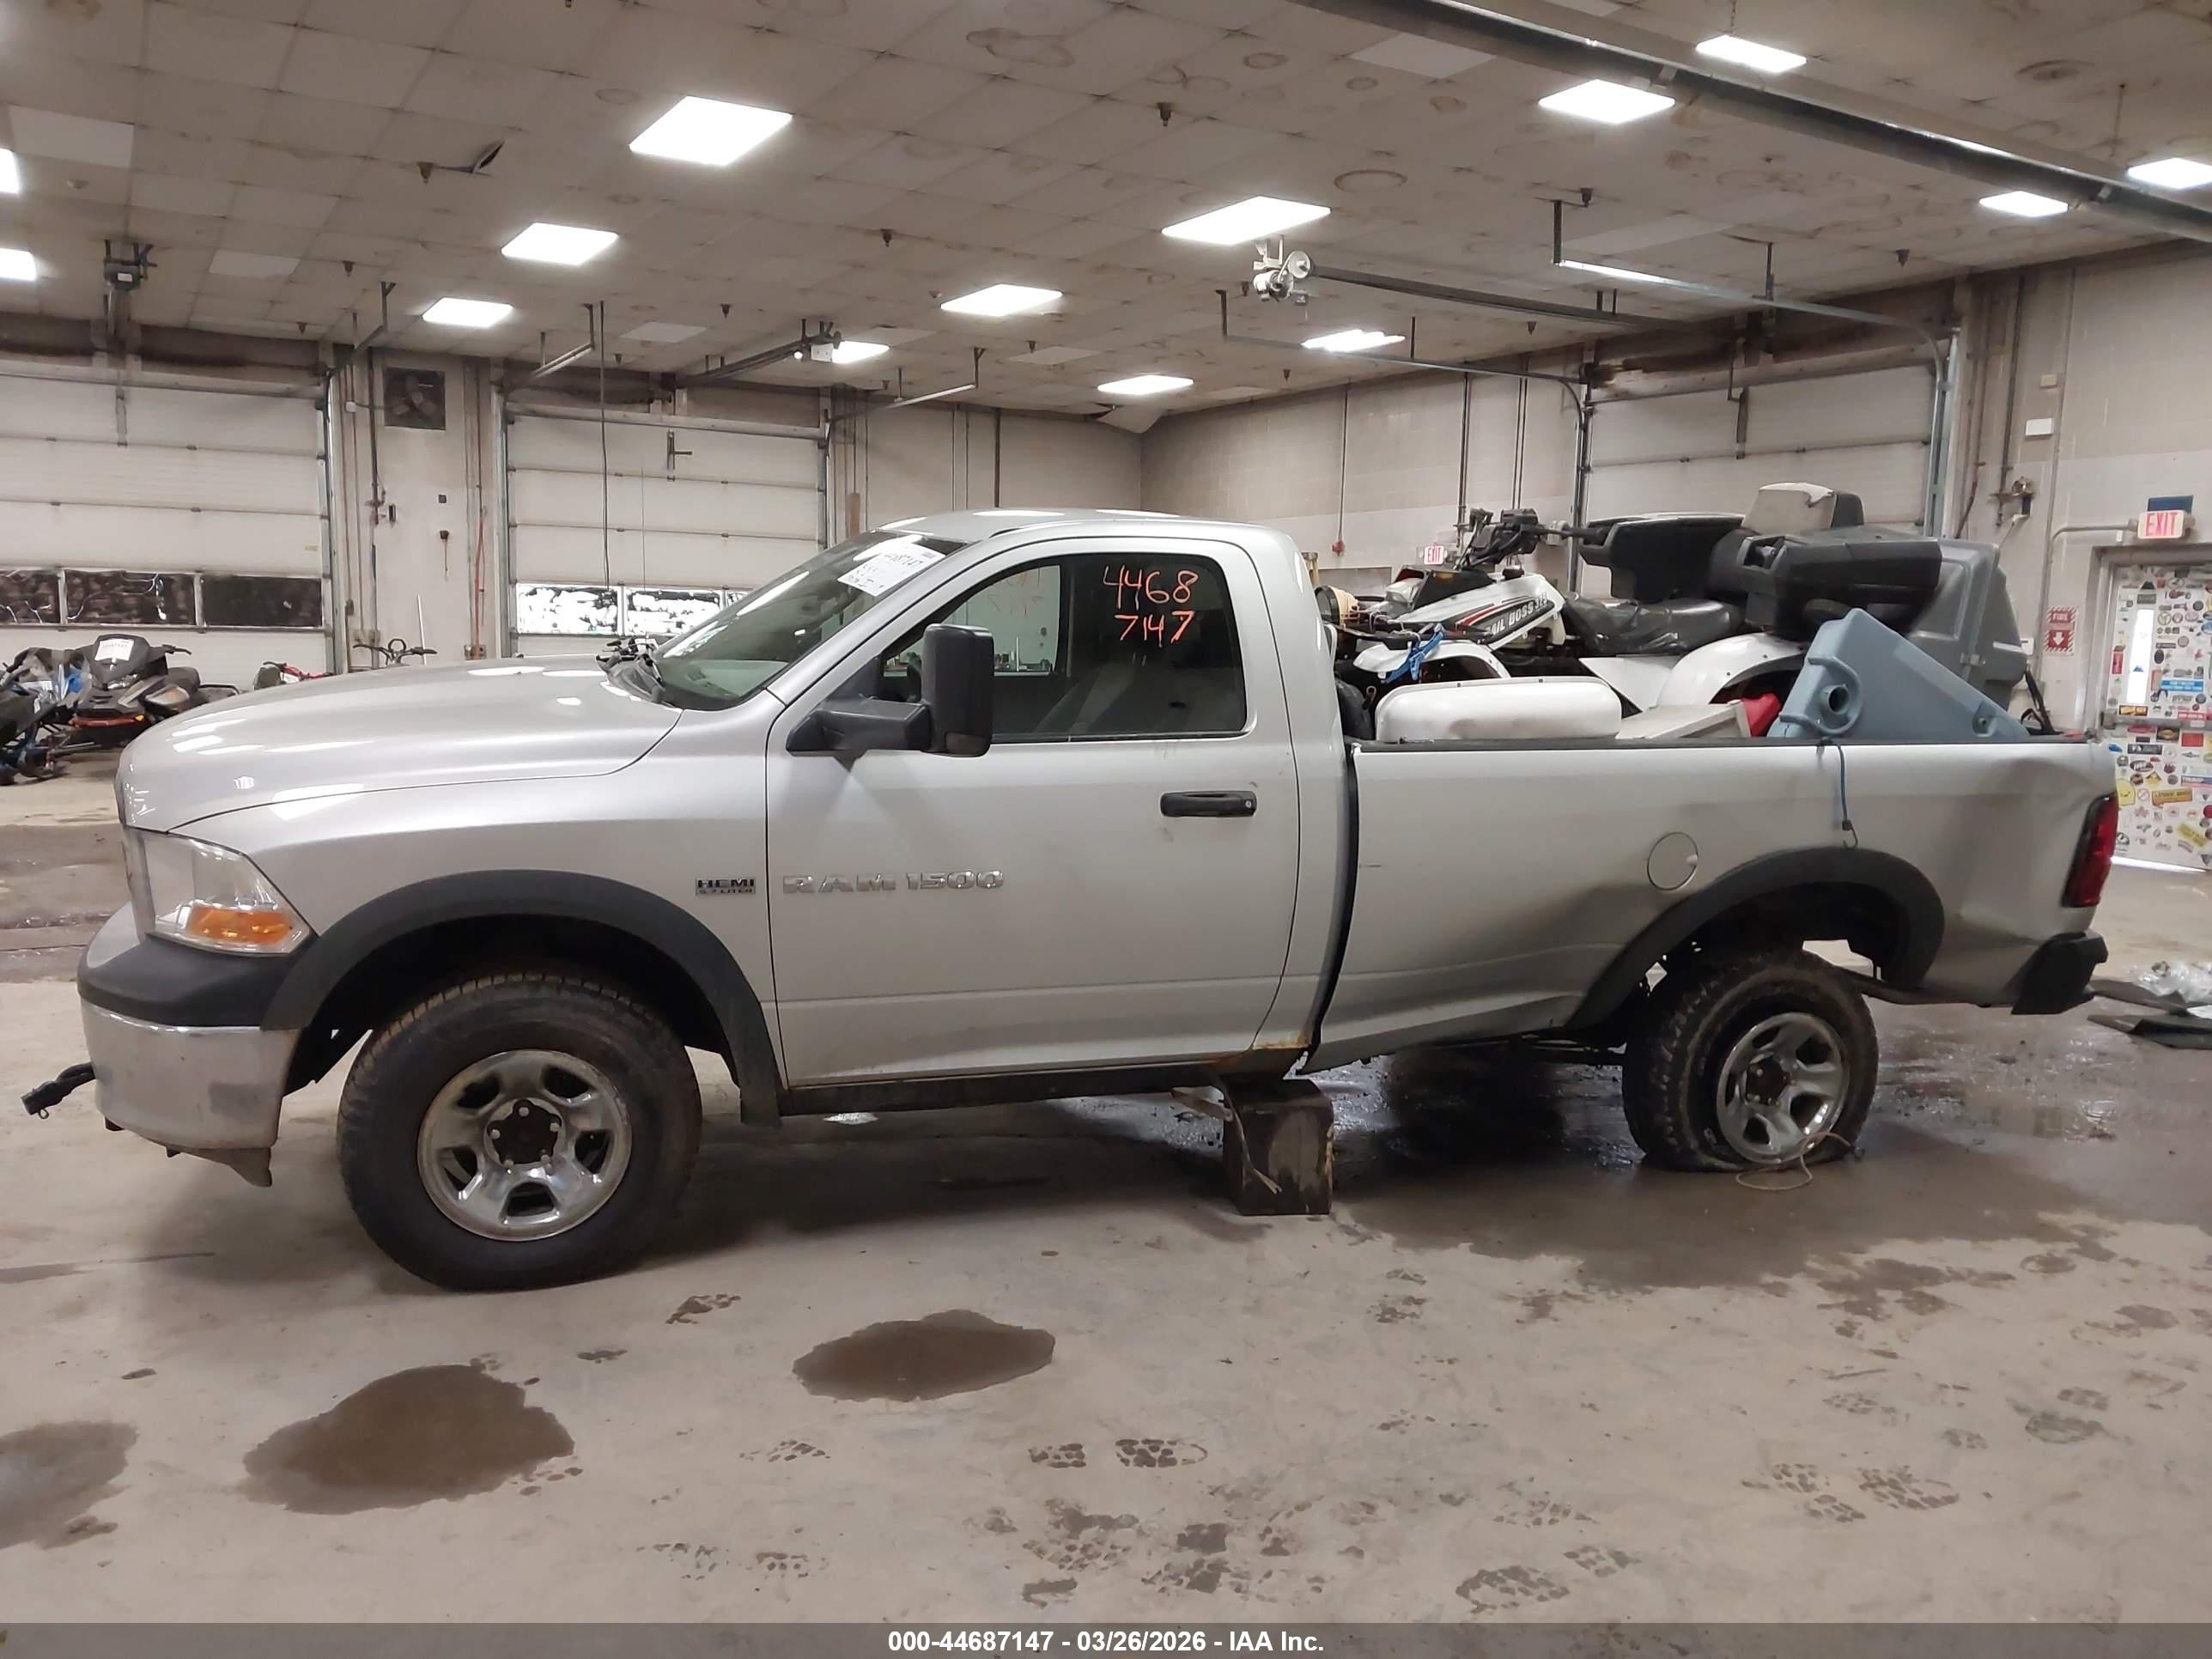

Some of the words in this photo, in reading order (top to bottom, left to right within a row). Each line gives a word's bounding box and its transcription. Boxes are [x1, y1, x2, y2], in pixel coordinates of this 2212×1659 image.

[2145, 512, 2178, 537] EXIT
[1427, 547, 1441, 562] EXIT
[1103, 564, 1199, 611] 4468
[1509, 601, 1534, 626] BOSS
[1113, 610, 1196, 647] 7147
[697, 878, 755, 888] HEMI
[782, 872, 896, 894] RAM
[904, 869, 1005, 890] 1500
